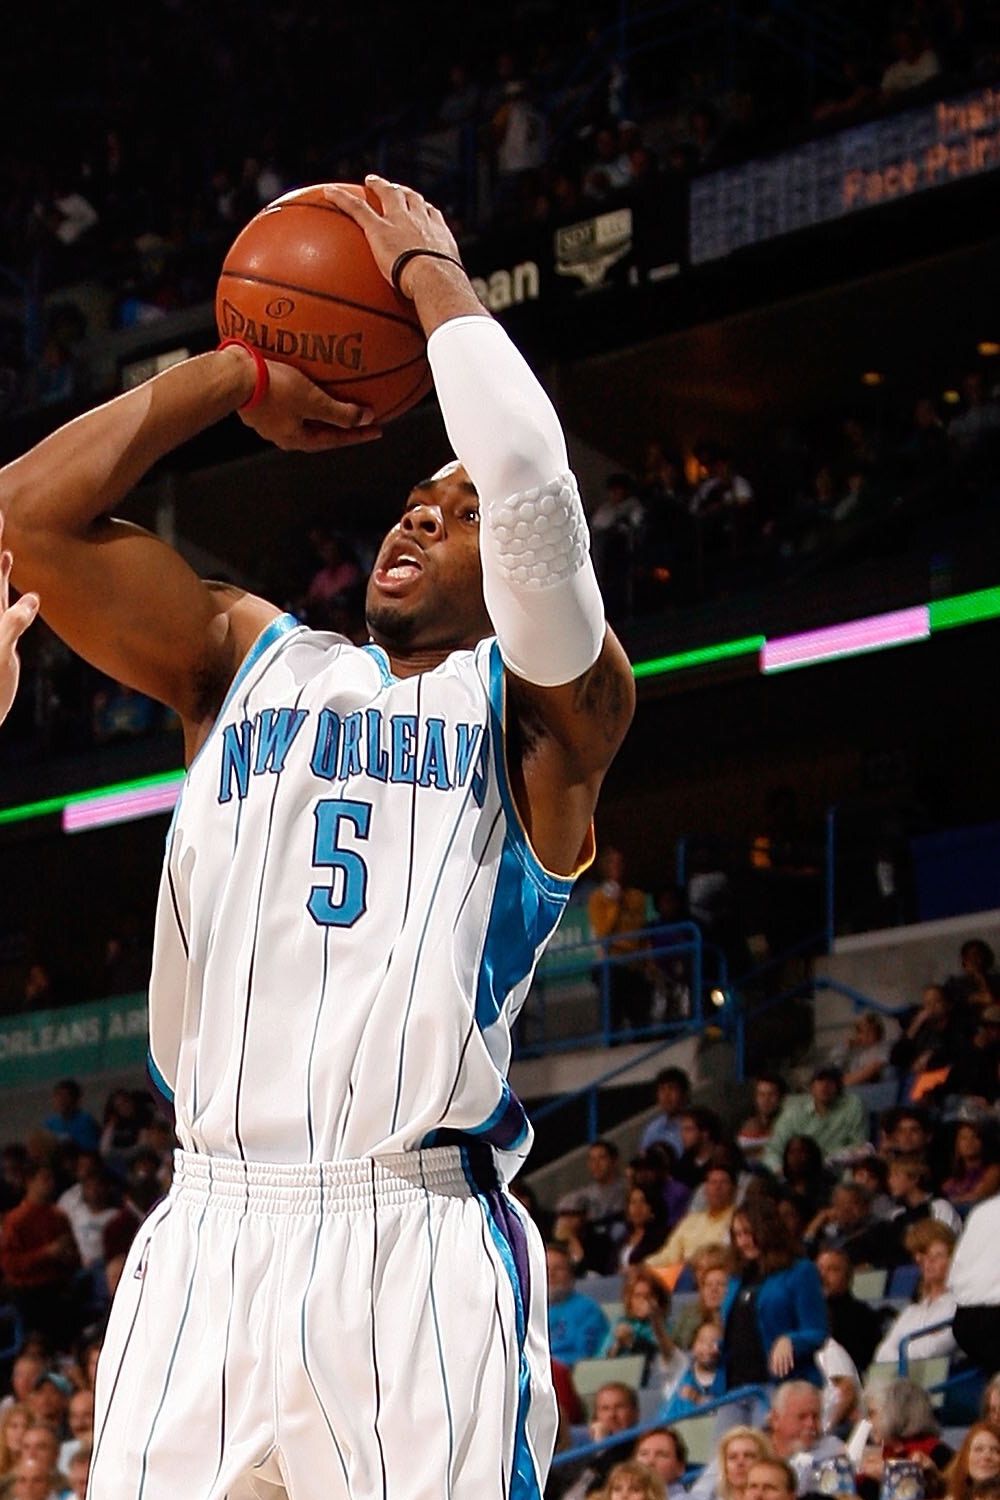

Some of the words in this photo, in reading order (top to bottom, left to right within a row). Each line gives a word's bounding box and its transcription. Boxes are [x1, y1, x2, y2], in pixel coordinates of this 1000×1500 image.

[221, 298, 363, 370] SPALDING
[217, 707, 310, 804] NW
[306, 798, 373, 928] 5
